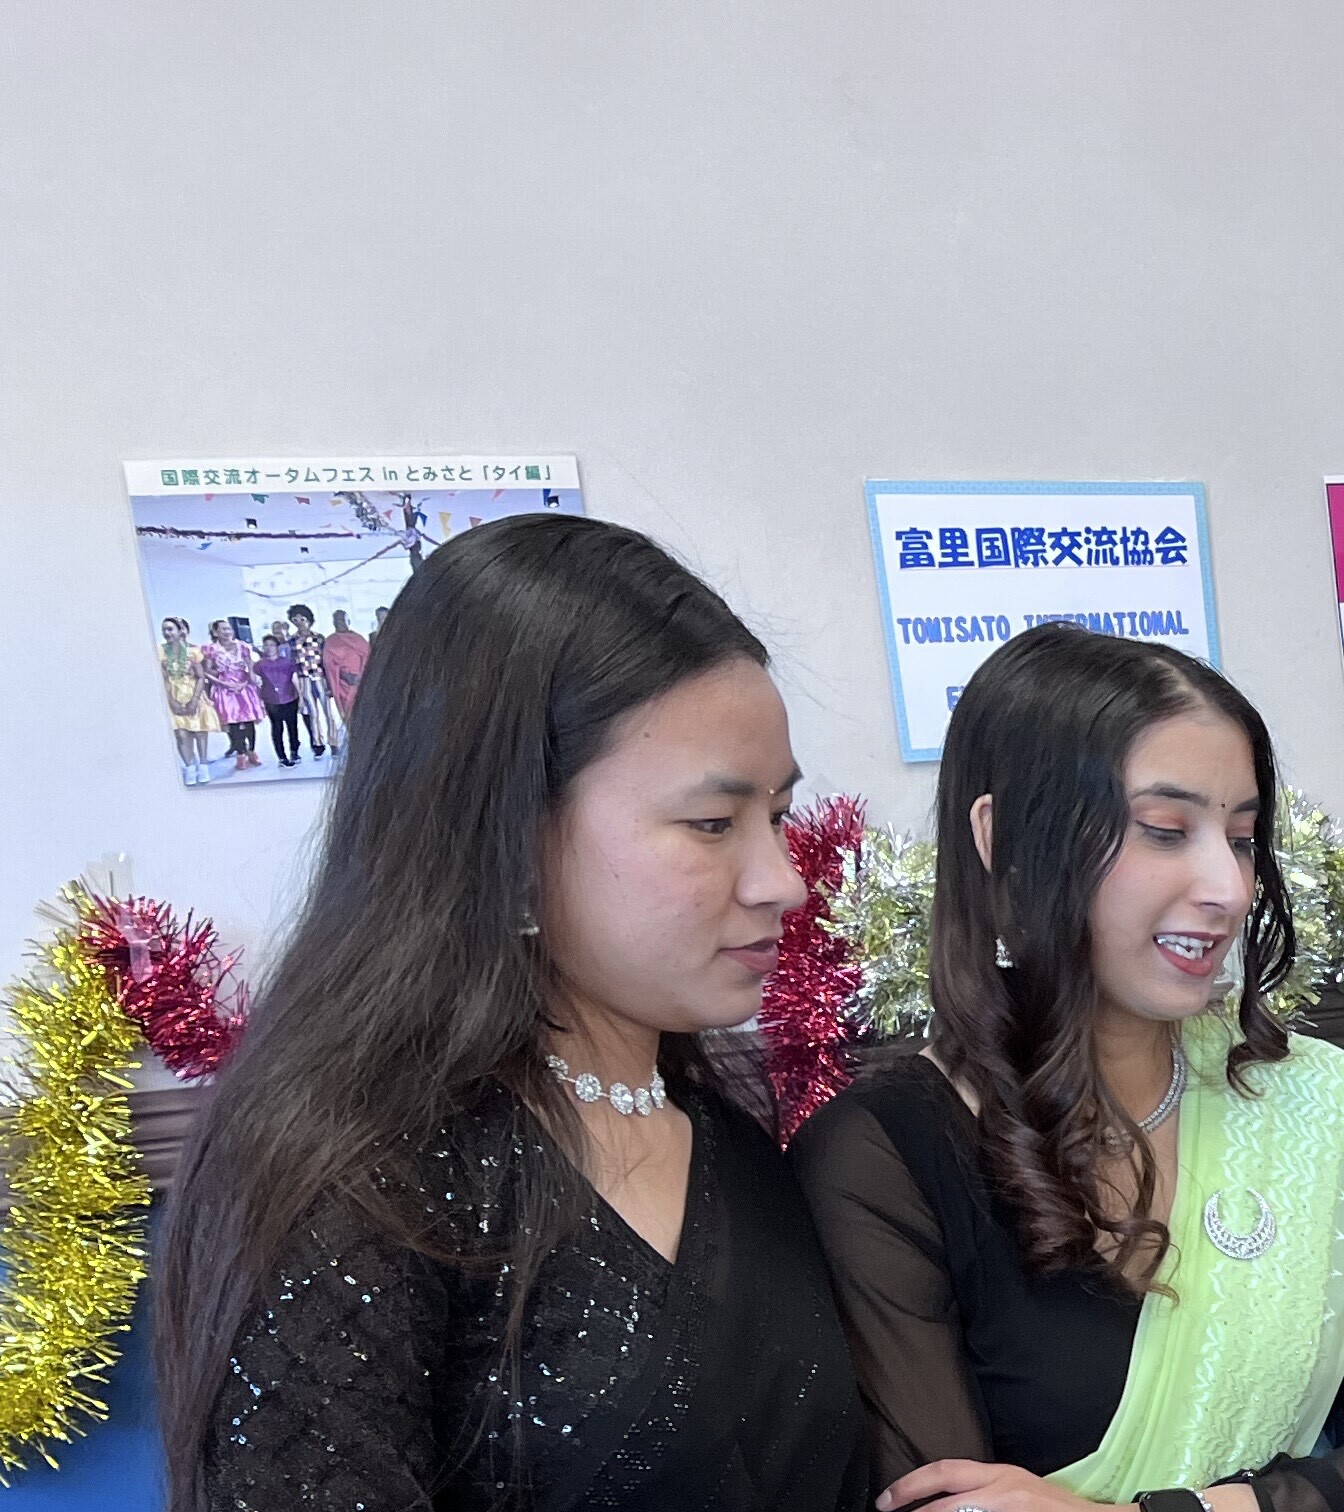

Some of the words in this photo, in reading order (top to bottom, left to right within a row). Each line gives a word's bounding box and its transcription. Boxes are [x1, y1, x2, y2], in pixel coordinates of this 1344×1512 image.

[160, 467, 375, 487] 国際交流オータムフェス
[895, 526, 1188, 569] 富里国際交流協会
[897, 615, 1011, 644] TOMISATO
[1023, 611, 1189, 638] IRNATIONAL
